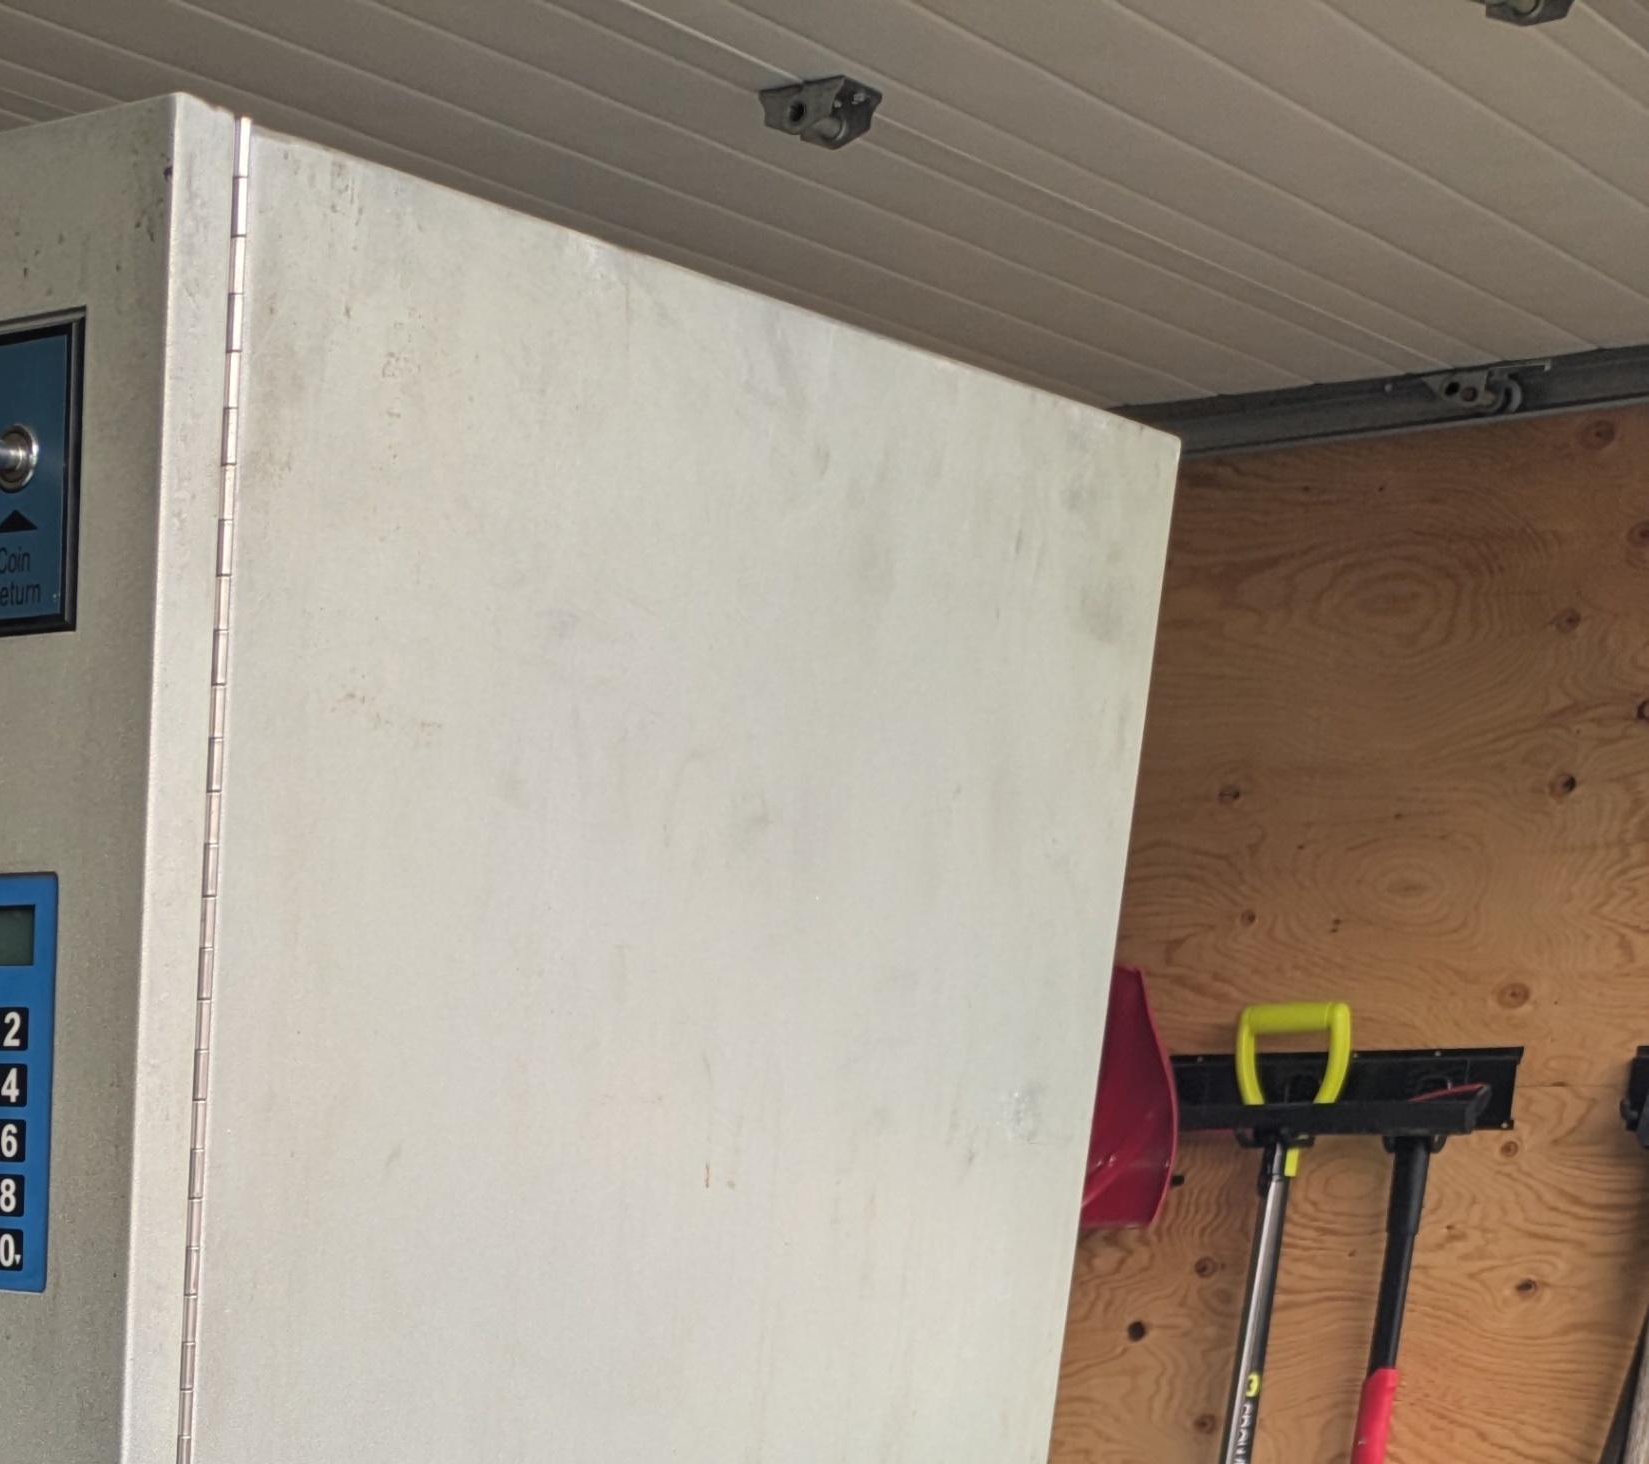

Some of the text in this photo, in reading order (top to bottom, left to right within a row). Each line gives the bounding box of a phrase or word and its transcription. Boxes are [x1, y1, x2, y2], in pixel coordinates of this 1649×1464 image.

[4, 1012, 20, 1047] 2
[1, 1068, 19, 1103] 4
[0, 1124, 18, 1158] 6
[0, 1178, 17, 1212] 8
[0, 1233, 15, 1267] 0
